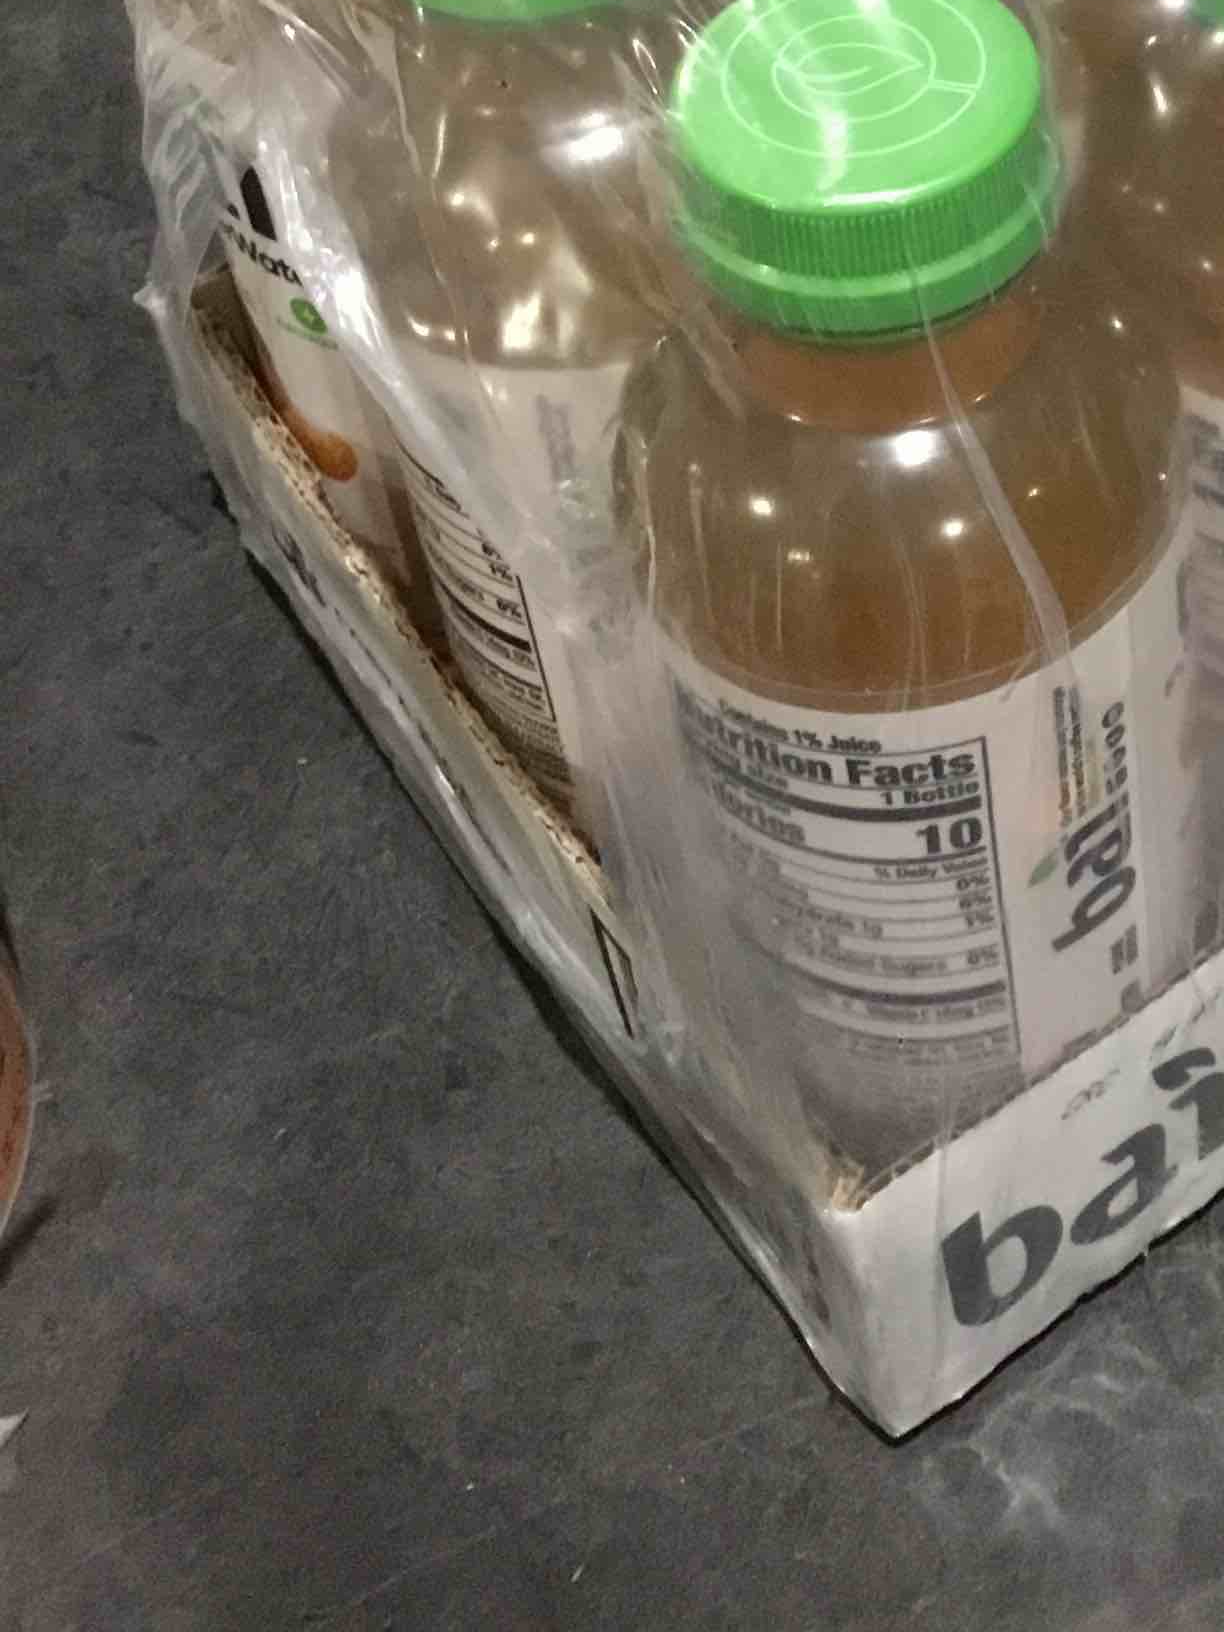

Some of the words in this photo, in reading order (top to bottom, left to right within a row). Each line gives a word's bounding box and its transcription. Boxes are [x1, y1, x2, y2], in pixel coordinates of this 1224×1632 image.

[793, 729, 824, 750] 1%
[827, 734, 883, 754] Juice
[844, 752, 977, 787] Facts
[881, 791, 893, 806] 1
[903, 779, 980, 805] Bottle
[915, 817, 983, 856] 10
